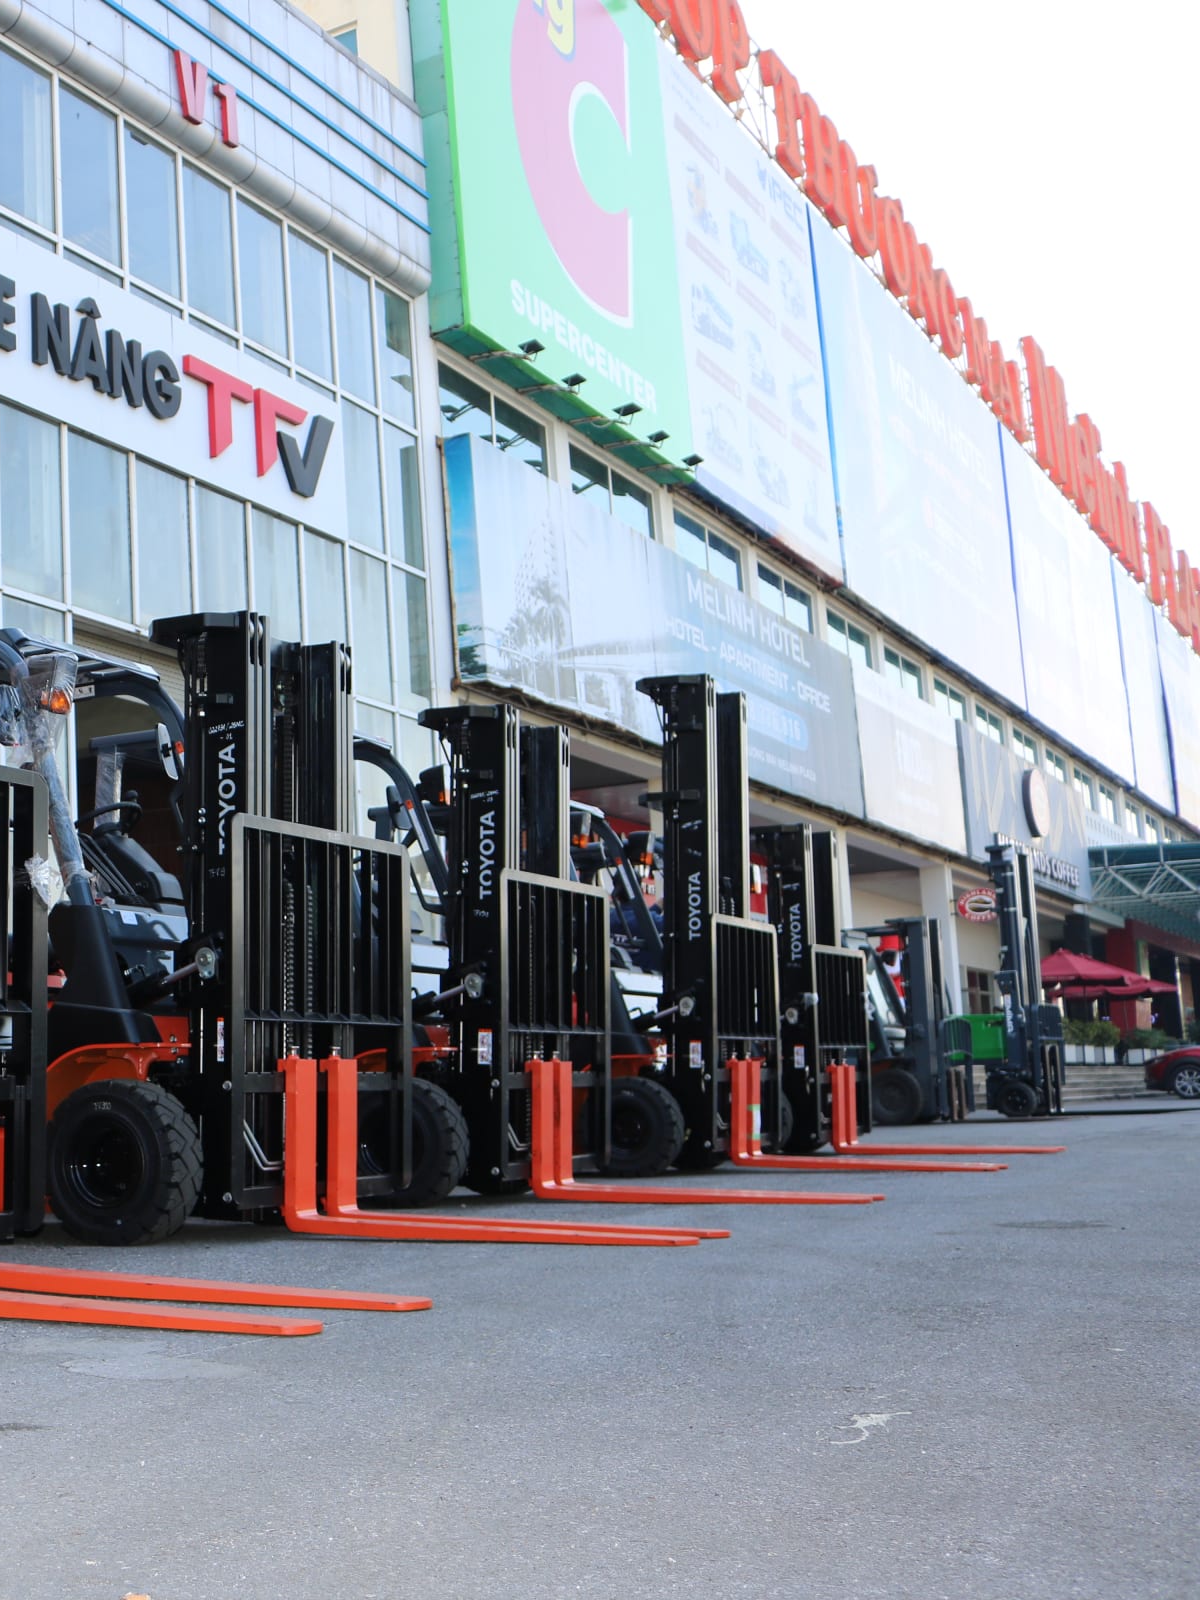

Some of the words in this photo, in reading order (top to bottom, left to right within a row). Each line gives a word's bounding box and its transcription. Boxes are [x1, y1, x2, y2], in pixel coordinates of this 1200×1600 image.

[174, 48, 239, 149] V1
[31, 292, 181, 420] NÂNG
[182, 354, 335, 499] TTV
[510, 279, 657, 415] SUPERCENTER
[664, 615, 709, 652] HOTEL
[719, 641, 790, 692] APARTMENT
[796, 678, 831, 713] OFFICE
[686, 571, 756, 638] MELINH
[759, 610, 811, 668] HOTEL
[479, 810, 495, 900] TOYOTA
[1051, 856, 1080, 887] COFFEE
[688, 871, 701, 941] TOYOTA
[789, 903, 802, 961] TOYOTA
